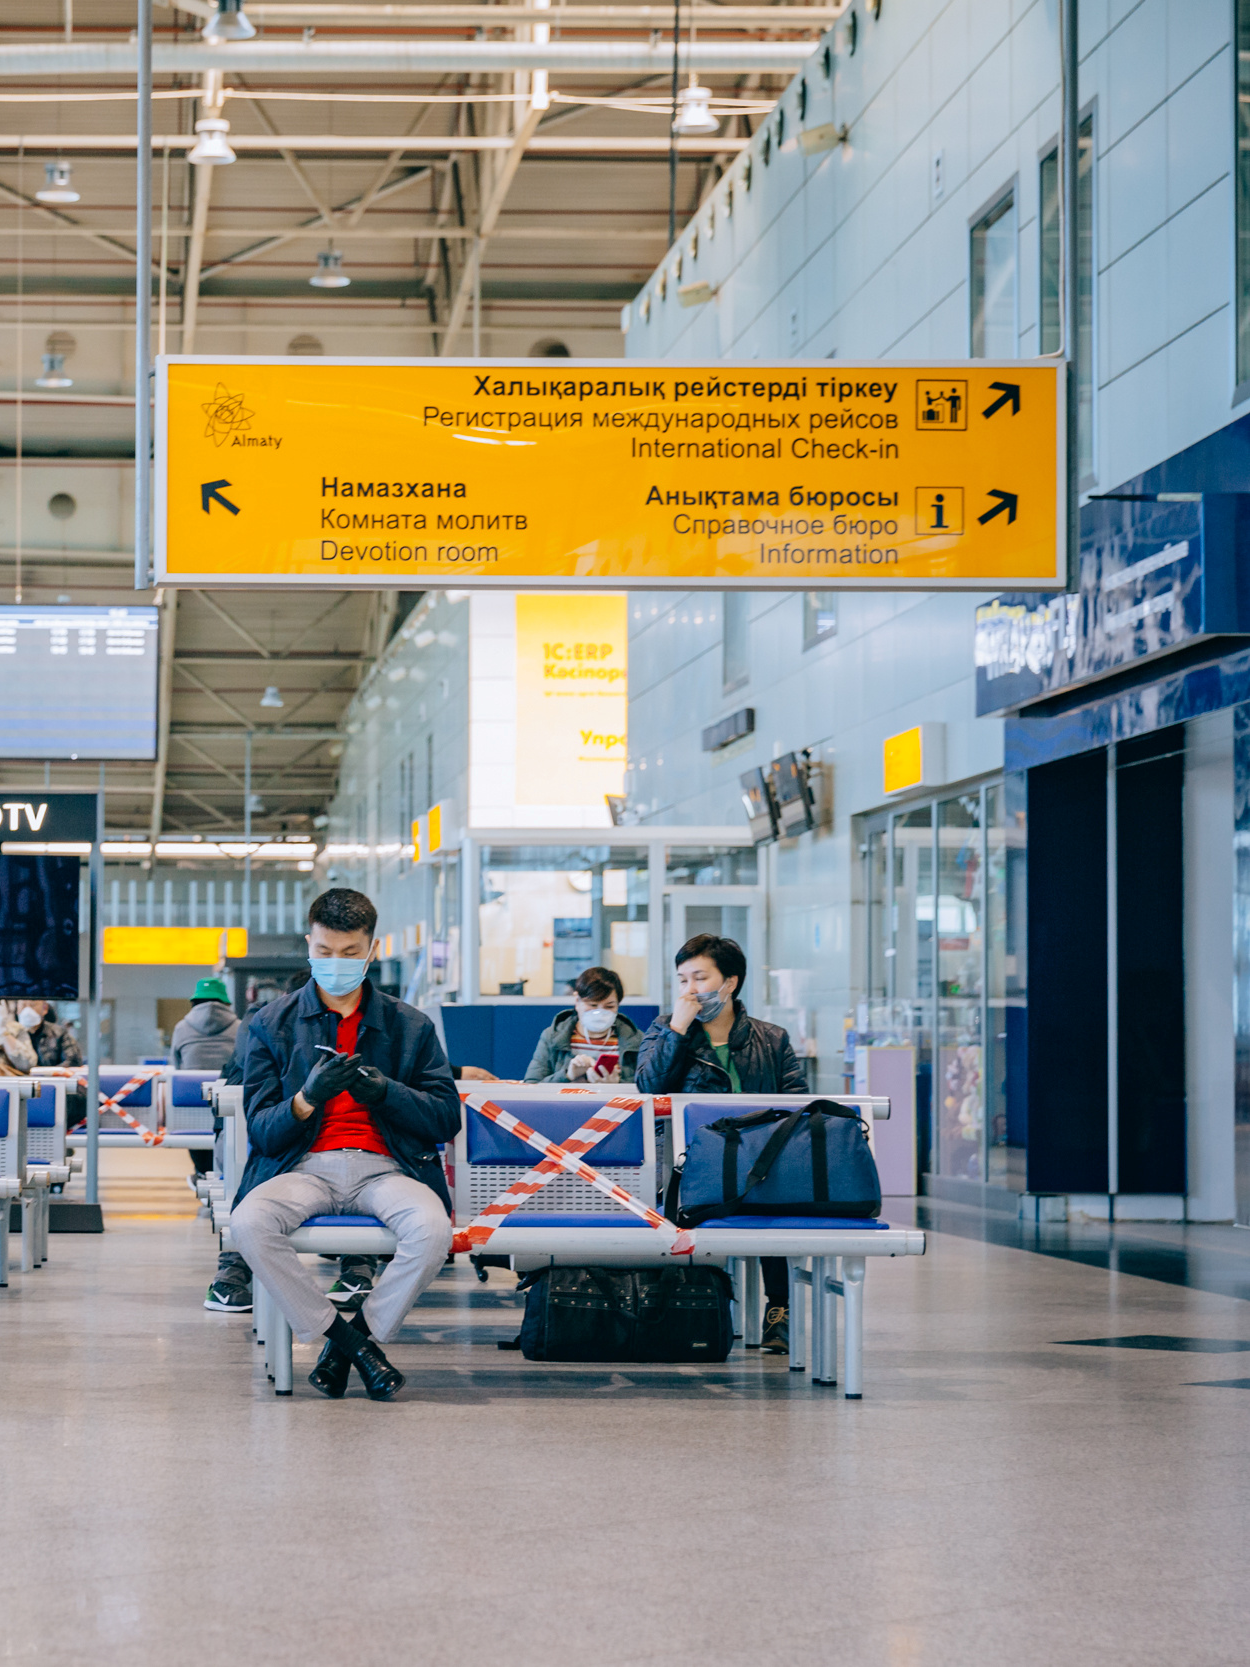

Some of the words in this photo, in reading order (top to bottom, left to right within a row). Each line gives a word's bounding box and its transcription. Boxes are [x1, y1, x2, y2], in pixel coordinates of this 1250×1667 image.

[473, 374, 665, 402] Халықаралық
[673, 376, 808, 403] рейстерді
[815, 377, 899, 403] тіркеу
[423, 405, 583, 431] Регистрация
[592, 410, 801, 434] международных
[809, 408, 899, 433] рейсов
[231, 434, 282, 449] Almaty
[631, 436, 782, 459] International
[790, 437, 899, 460] Check-in
[321, 476, 467, 498] Намазхана
[645, 485, 780, 509] Анықтама
[788, 486, 899, 511] бюросы
[320, 508, 427, 530] Комната
[436, 514, 528, 530] молитв
[672, 513, 824, 539] Справочное
[833, 514, 899, 540] бюро
[320, 540, 427, 561] Devotion
[437, 545, 498, 562] room
[760, 543, 899, 565] Information
